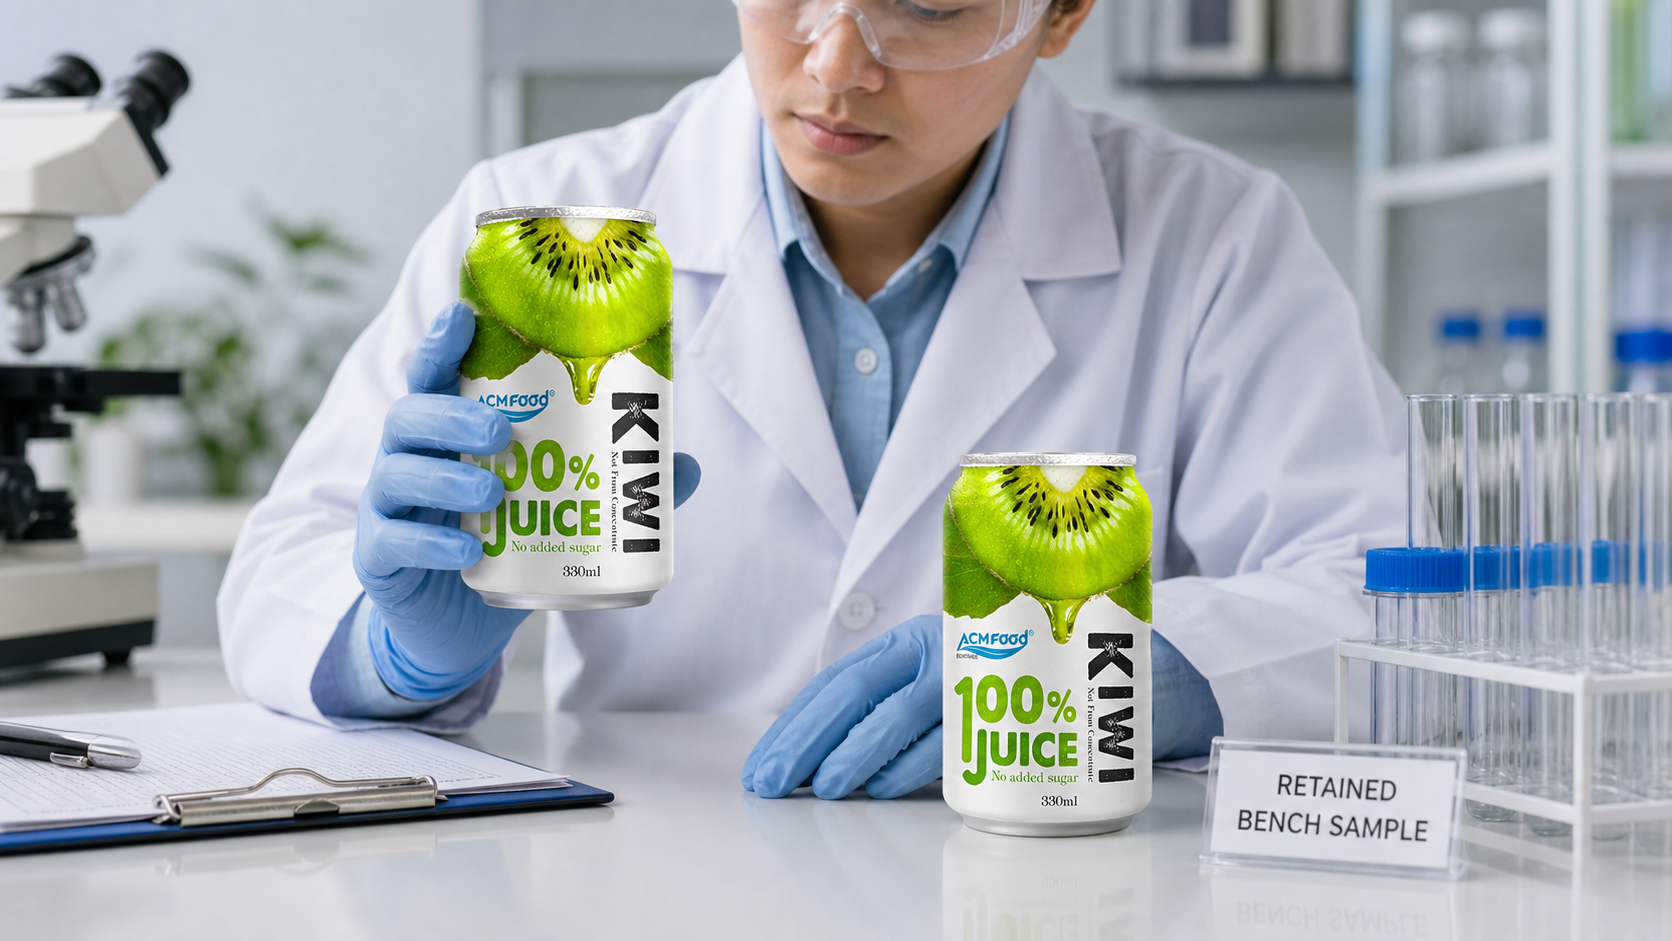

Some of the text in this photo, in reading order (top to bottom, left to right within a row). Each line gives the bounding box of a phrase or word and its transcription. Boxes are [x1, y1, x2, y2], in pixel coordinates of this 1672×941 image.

[611, 392, 660, 554] KIWI
[482, 497, 600, 557] JUICE
[511, 540, 601, 556] No added sugar
[563, 565, 601, 577] 330ml
[1087, 687, 1095, 702] Not
[1088, 633, 1135, 783] KIWI
[954, 674, 1077, 763] 100%
[962, 729, 1078, 786] JUICE
[991, 770, 1079, 786] No added sugar
[1277, 774, 1397, 801] RETAINED
[1041, 795, 1078, 806] 330ml
[1237, 809, 1428, 842] BENCH SAMPLE
